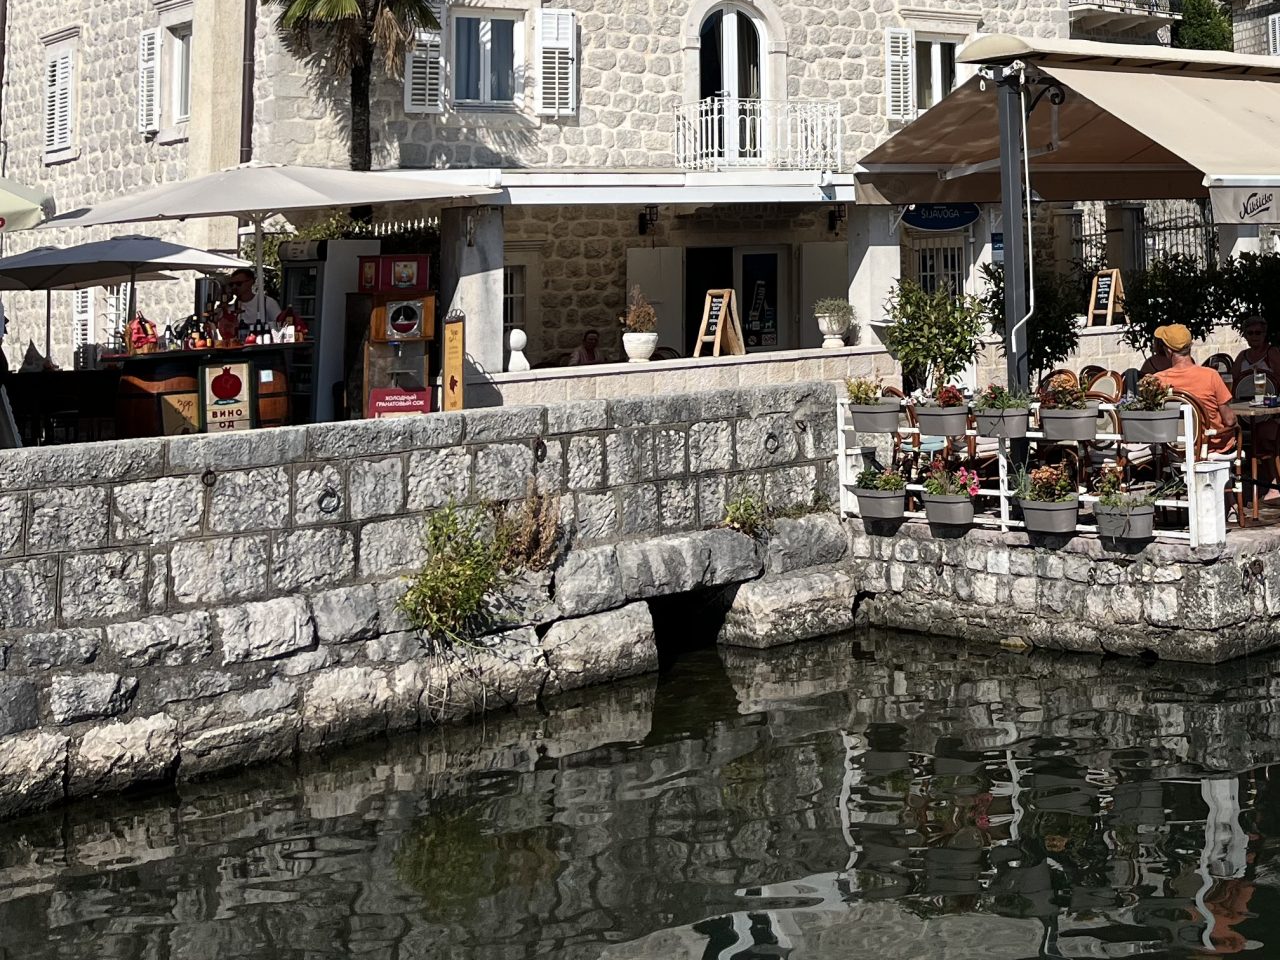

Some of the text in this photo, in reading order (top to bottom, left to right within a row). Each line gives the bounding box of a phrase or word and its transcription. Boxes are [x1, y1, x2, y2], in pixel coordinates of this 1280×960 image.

[920, 207, 960, 218] ŠIJAVOGA
[385, 393, 417, 401] ХОЛОДНЫЙ
[211, 408, 243, 419] ВИНО
